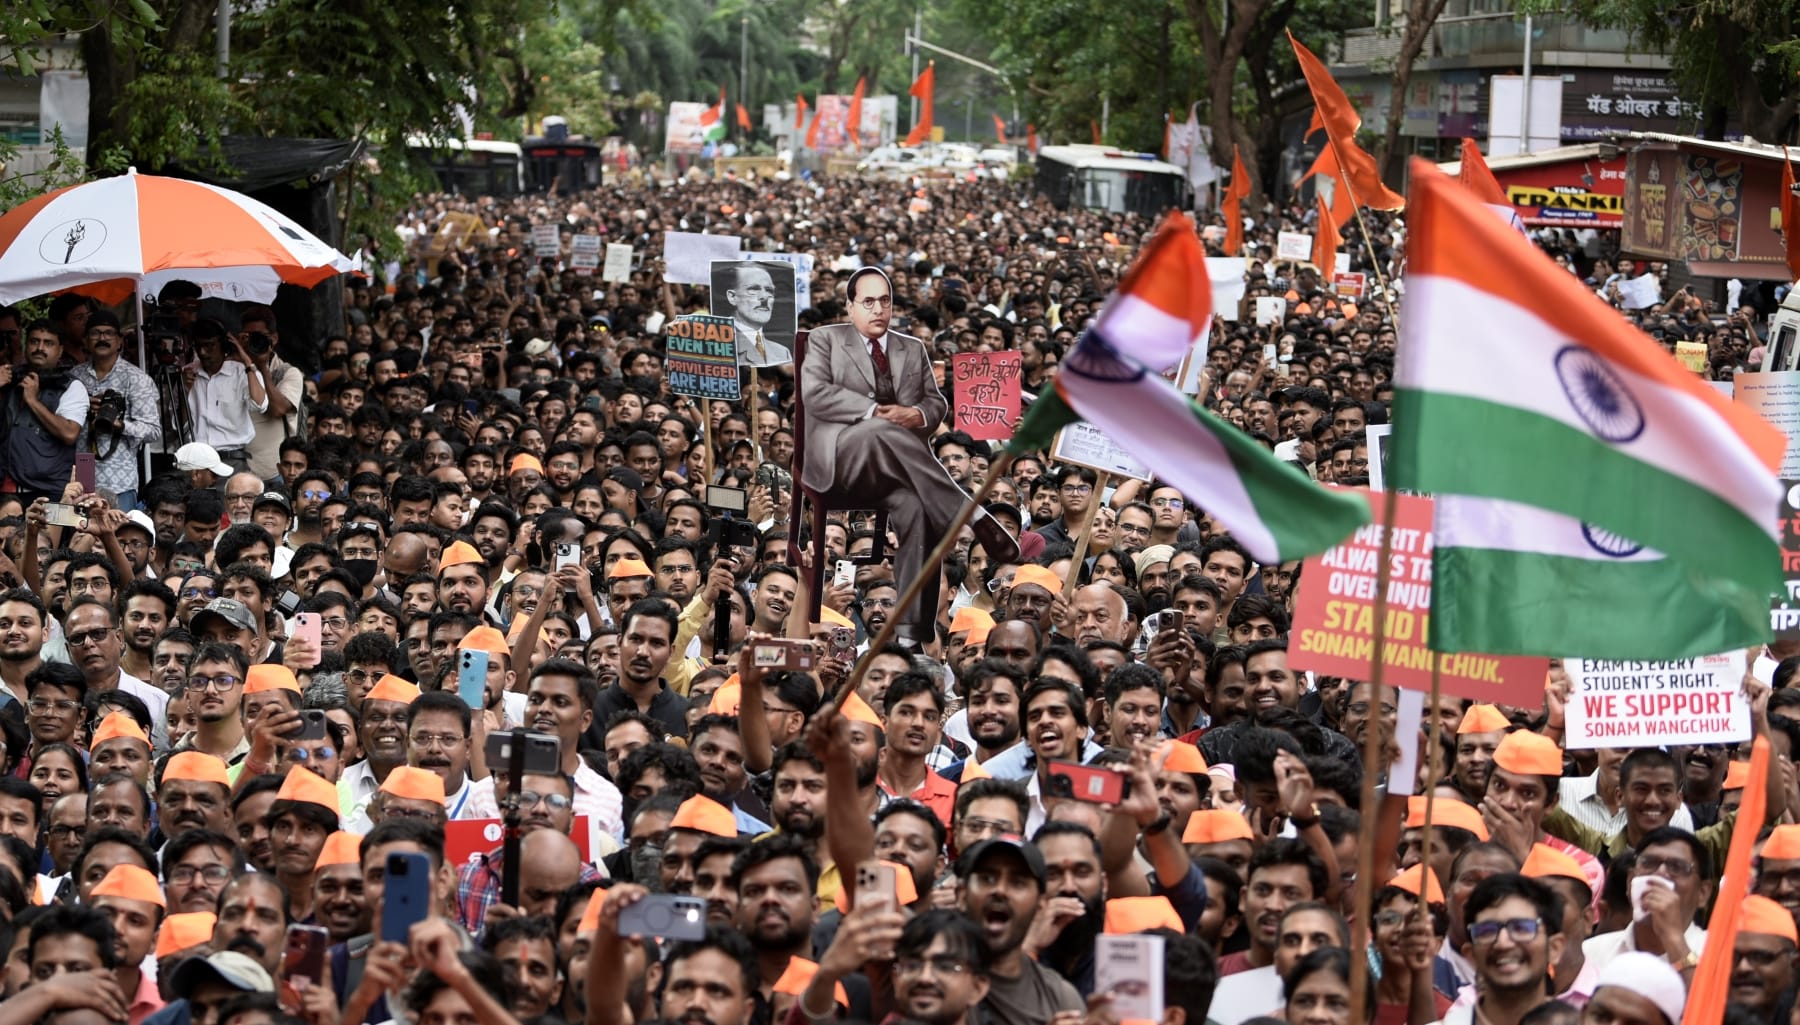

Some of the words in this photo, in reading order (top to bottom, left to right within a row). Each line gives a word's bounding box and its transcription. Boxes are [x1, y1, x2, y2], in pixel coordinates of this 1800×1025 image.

[1614, 94, 1661, 118] ओव्हर
[1513, 194, 1624, 210] FRANKI
[669, 320, 691, 336] SO
[693, 321, 734, 343] BAD
[668, 336, 703, 354] EVEN
[705, 341, 734, 357] THE
[669, 360, 737, 378] PRIVILEGED
[670, 371, 697, 389] ARE
[699, 375, 738, 394] HERE
[957, 403, 1013, 429] सरकार
[1354, 523, 1420, 552] MERIT
[1321, 546, 1407, 578] ALWAS
[1386, 581, 1432, 610] INJU
[1299, 629, 1374, 662] SONAM
[1582, 658, 1624, 673] EXAM
[1630, 659, 1643, 672] IS
[1649, 656, 1696, 672] EVERY
[1583, 674, 1665, 691] STUDENT'S
[1669, 673, 1720, 690] RIGHT.
[1584, 695, 1618, 718] WE
[1624, 691, 1735, 718] SUPPORT
[1585, 721, 1640, 738] SONAM
[1644, 717, 1737, 736] WANGCHUK.
